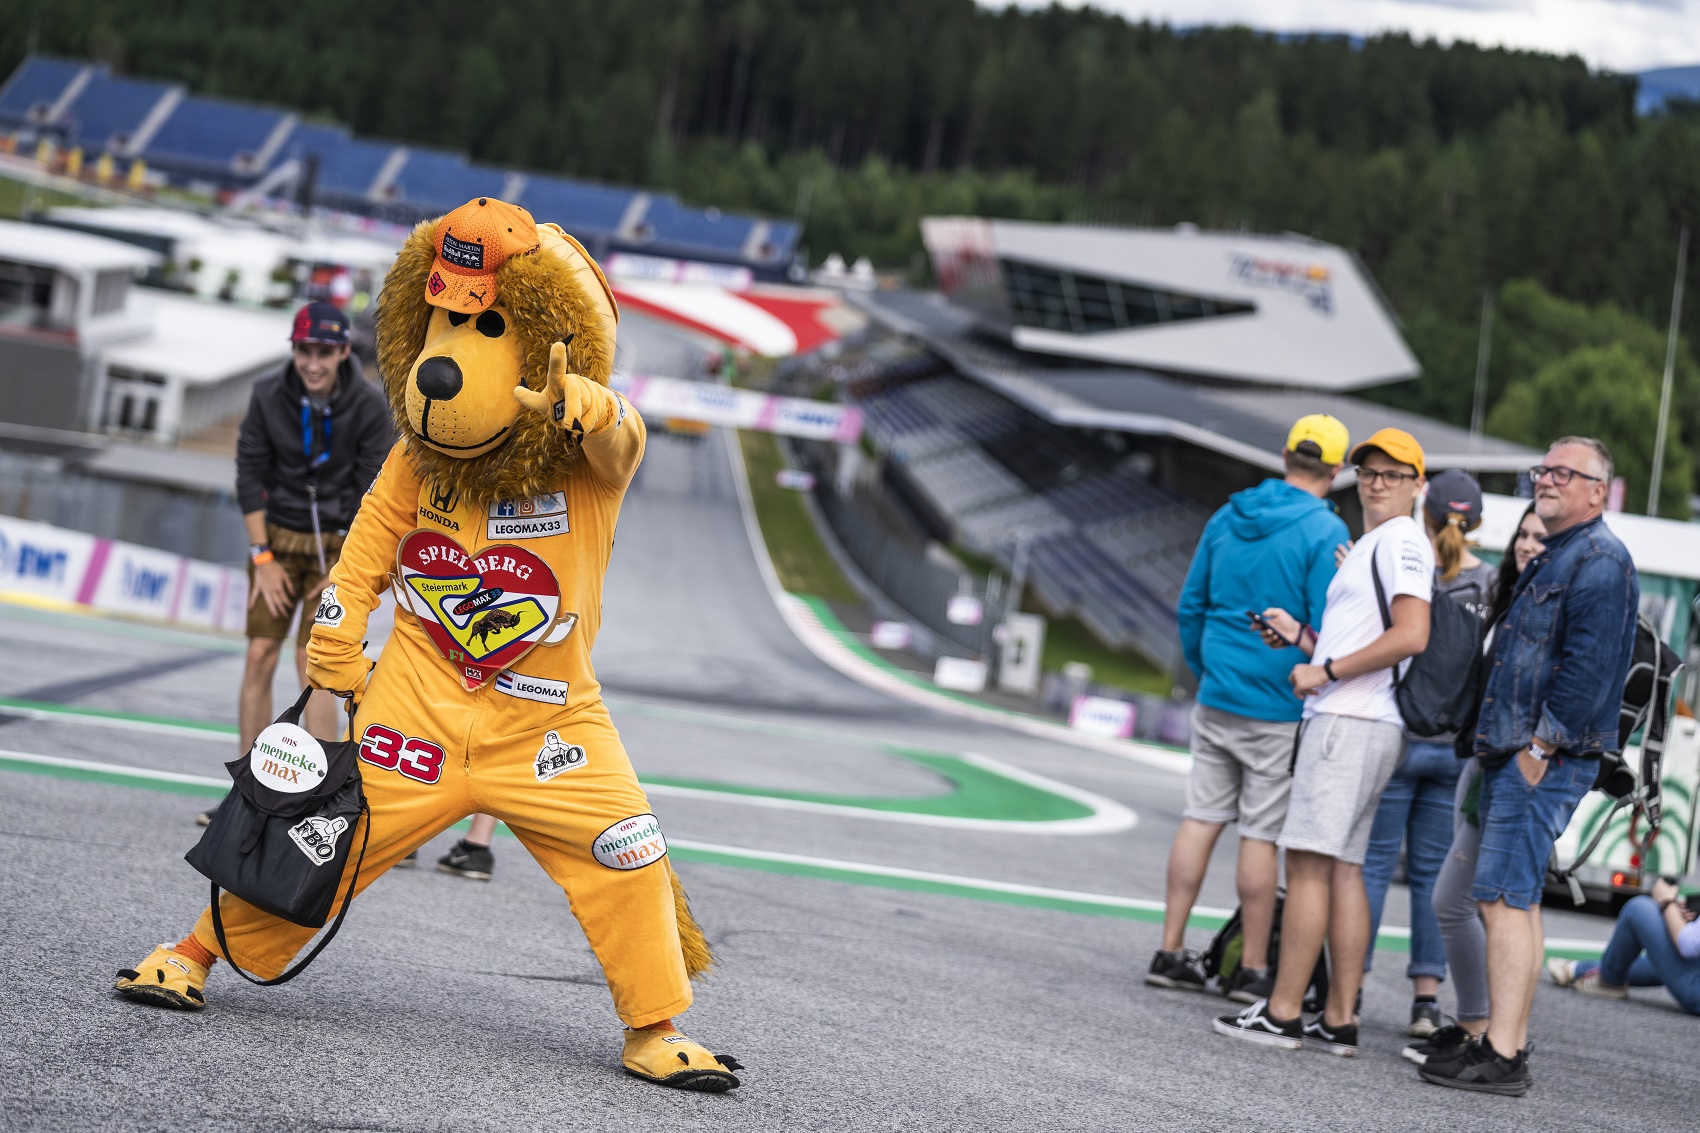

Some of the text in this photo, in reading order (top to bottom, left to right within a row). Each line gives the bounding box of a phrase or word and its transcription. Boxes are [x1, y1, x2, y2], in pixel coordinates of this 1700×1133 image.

[459, 243, 481, 252] MARTIN
[443, 251, 480, 267] RACING
[419, 506, 460, 531] HONDA
[495, 520, 561, 534] LEGOMAX33
[421, 581, 468, 592] Steiermark
[449, 648, 464, 662] F1
[516, 682, 566, 699] LEGOMAX
[282, 735, 298, 747] ons
[259, 742, 317, 773] menneke
[359, 724, 445, 783] 33
[536, 746, 583, 776] FBO
[261, 759, 302, 785] max
[620, 820, 638, 832] ons
[294, 820, 333, 859] FBO
[615, 839, 662, 866] max
